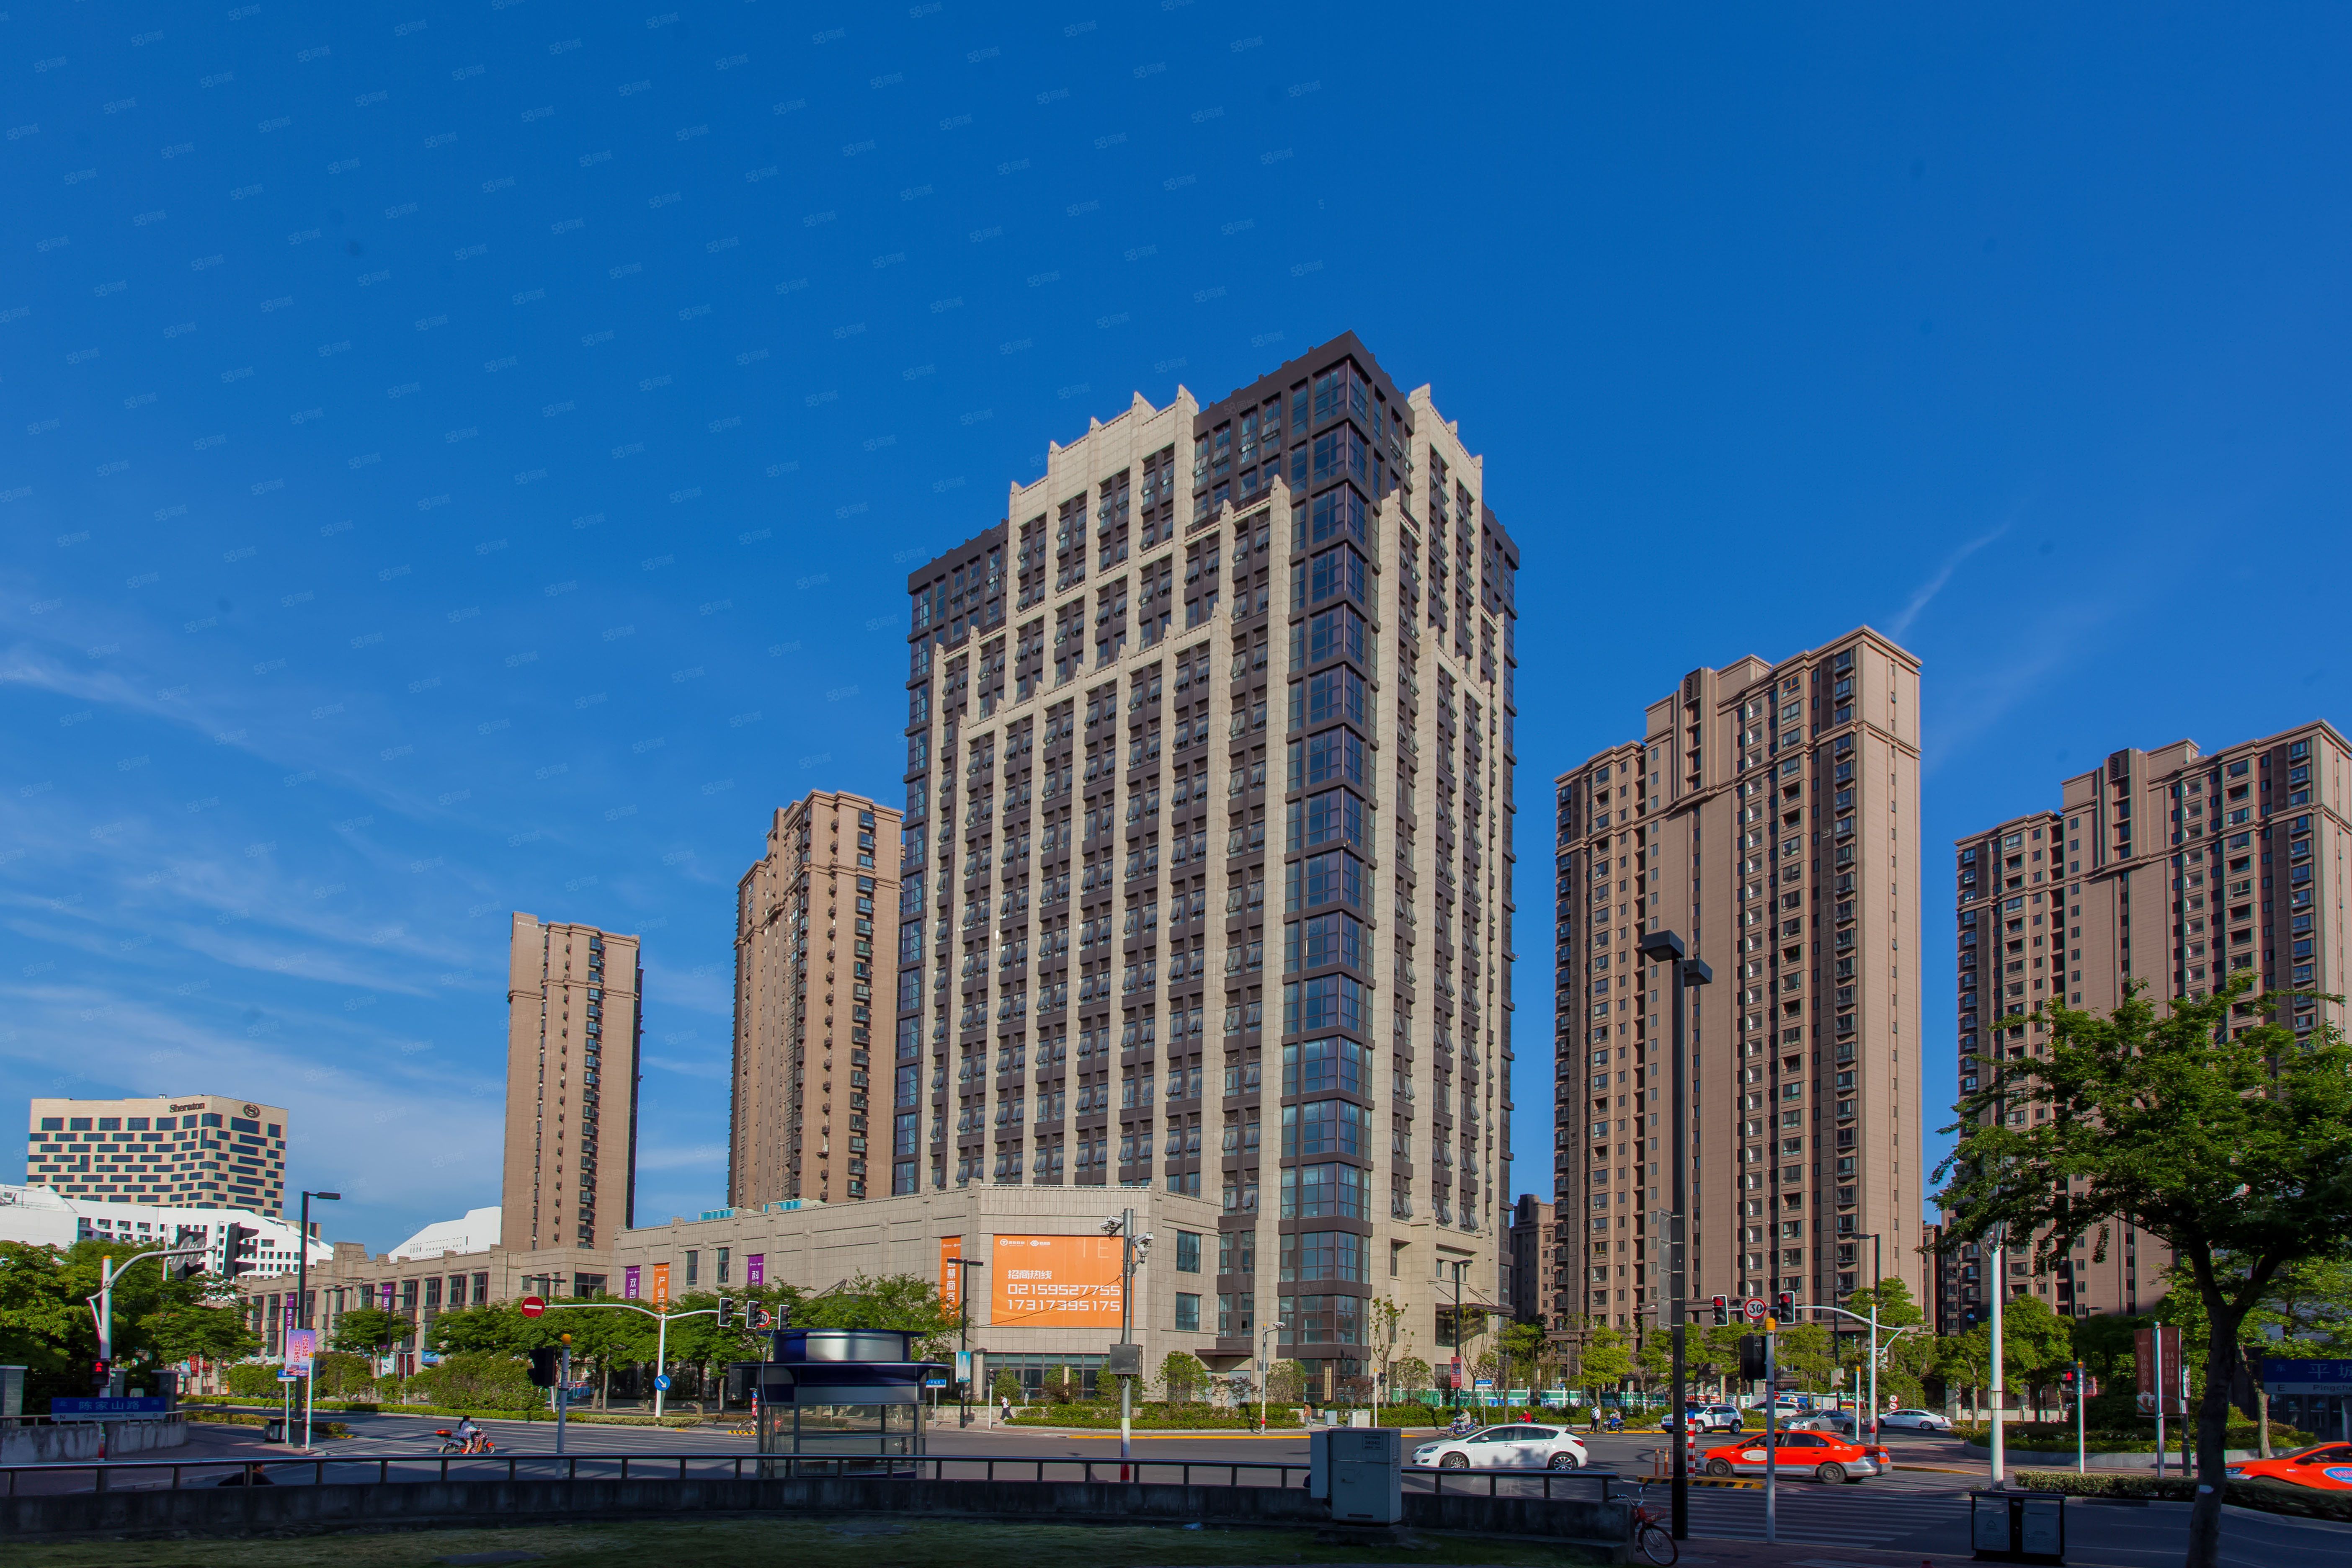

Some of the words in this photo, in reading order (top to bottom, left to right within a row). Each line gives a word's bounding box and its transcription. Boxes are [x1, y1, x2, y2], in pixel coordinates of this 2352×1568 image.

[170, 1102, 206, 1113] Sheraton
[1008, 1270, 1052, 1279] 招商热线
[629, 1278, 637, 1298] 双创
[946, 1257, 957, 1315] 智慧商务
[1008, 1284, 1121, 1296] 02159527755
[1008, 1299, 1121, 1312] 17317395175
[1749, 1304, 1763, 1313] 30
[79, 1400, 140, 1411] 陈家山路
